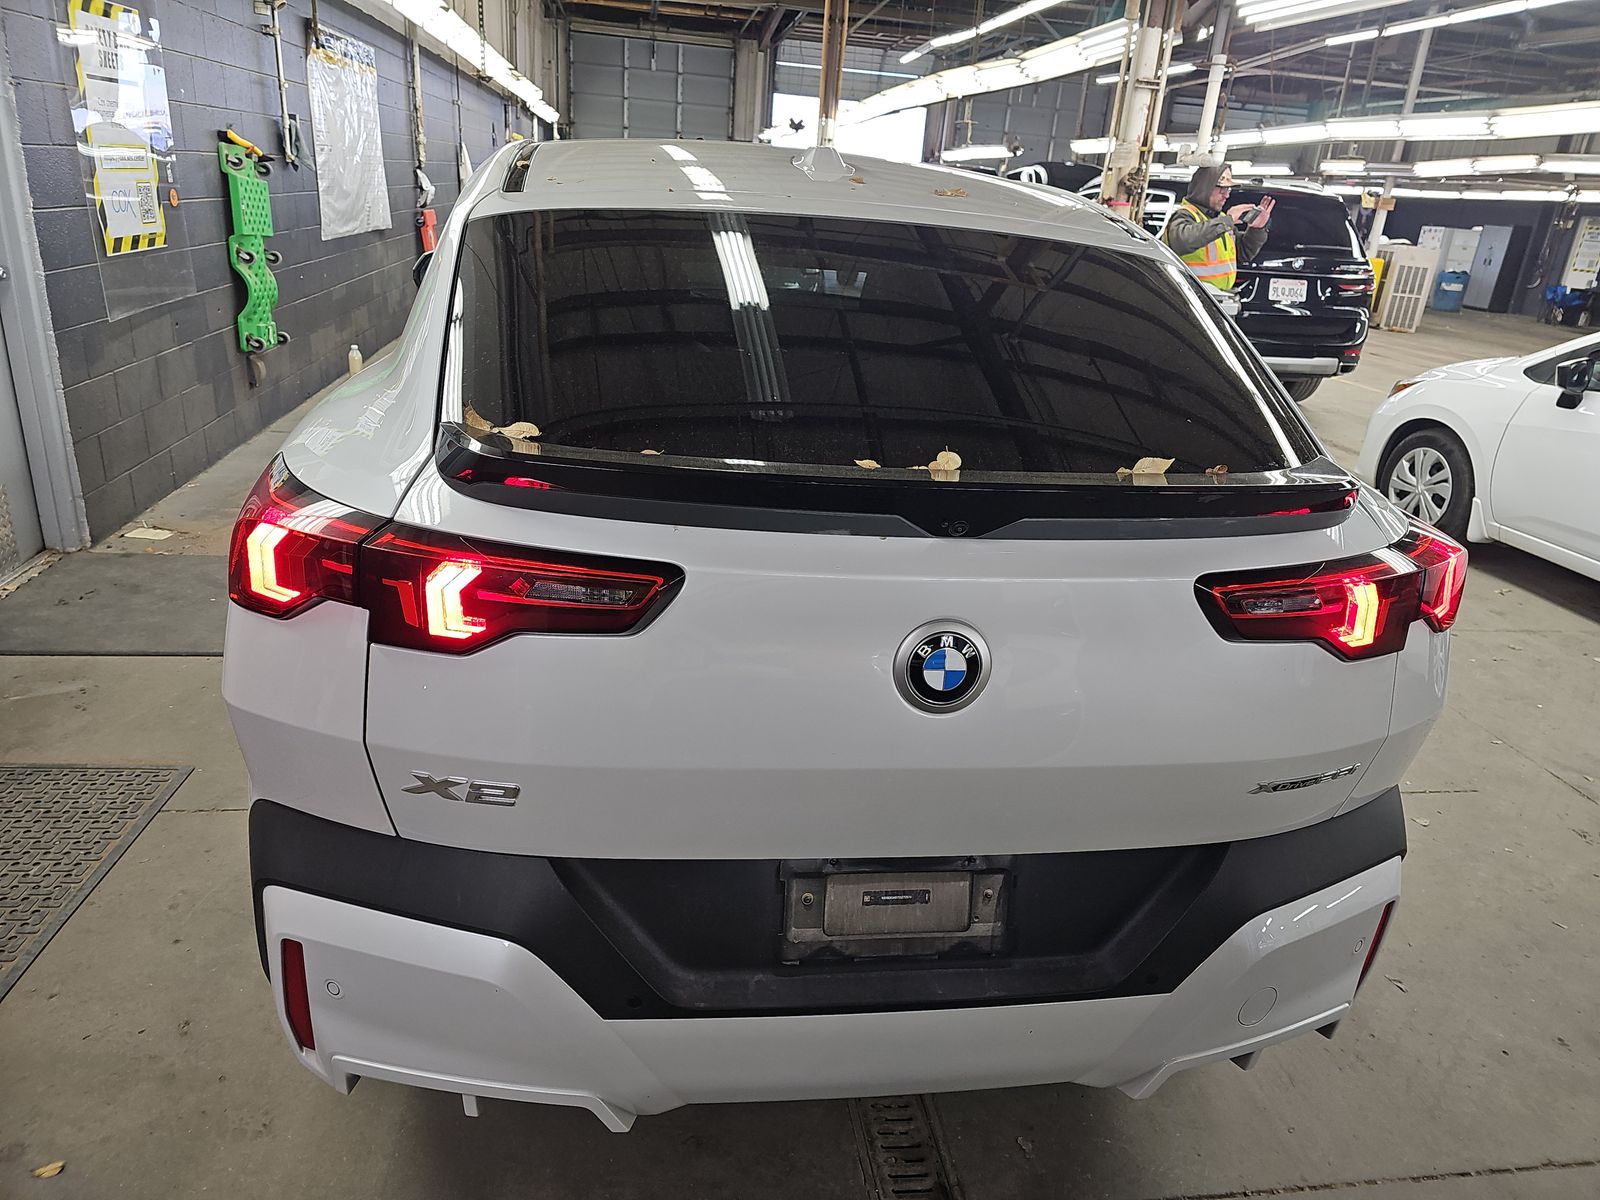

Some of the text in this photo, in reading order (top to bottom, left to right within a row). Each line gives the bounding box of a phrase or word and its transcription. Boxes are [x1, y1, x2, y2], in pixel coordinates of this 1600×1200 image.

[111, 189, 137, 218] COX
[917, 635, 976, 659] BMW
[400, 769, 521, 807] X2
